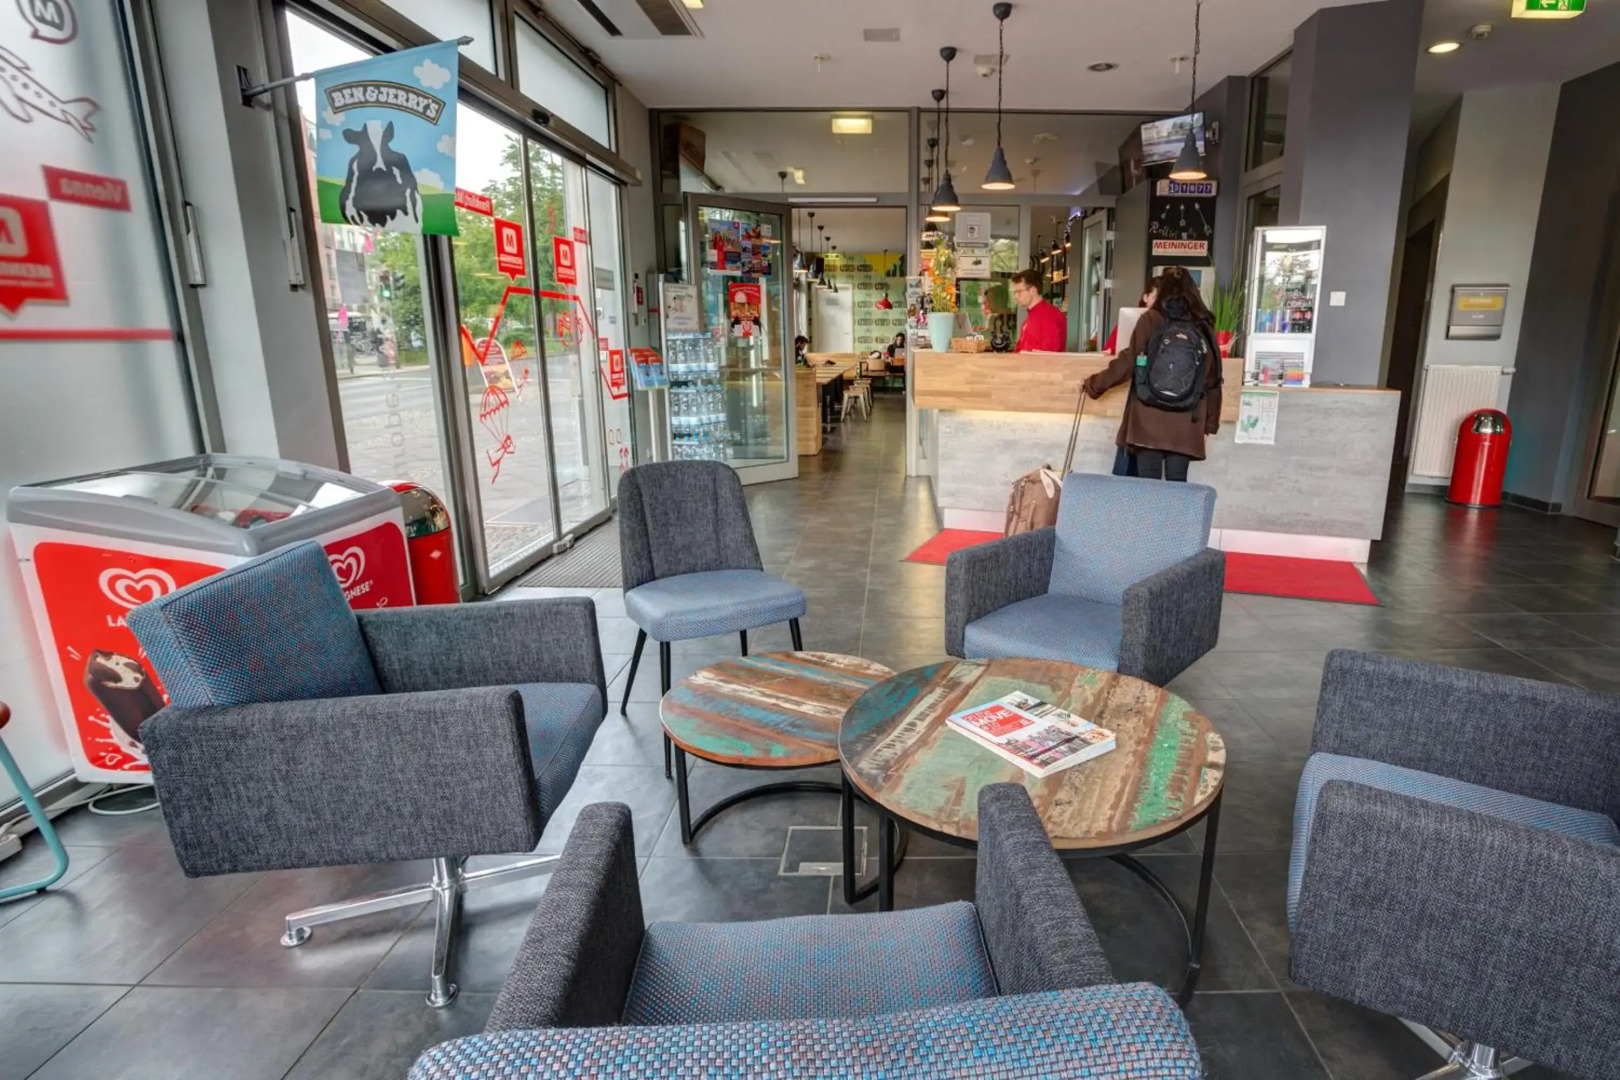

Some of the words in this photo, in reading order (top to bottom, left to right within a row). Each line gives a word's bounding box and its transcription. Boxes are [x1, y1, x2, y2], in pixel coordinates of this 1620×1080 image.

[1153, 241, 1205, 250] MEININGER
[344, 580, 371, 601] GNESE
[972, 709, 1012, 726] MOVE
